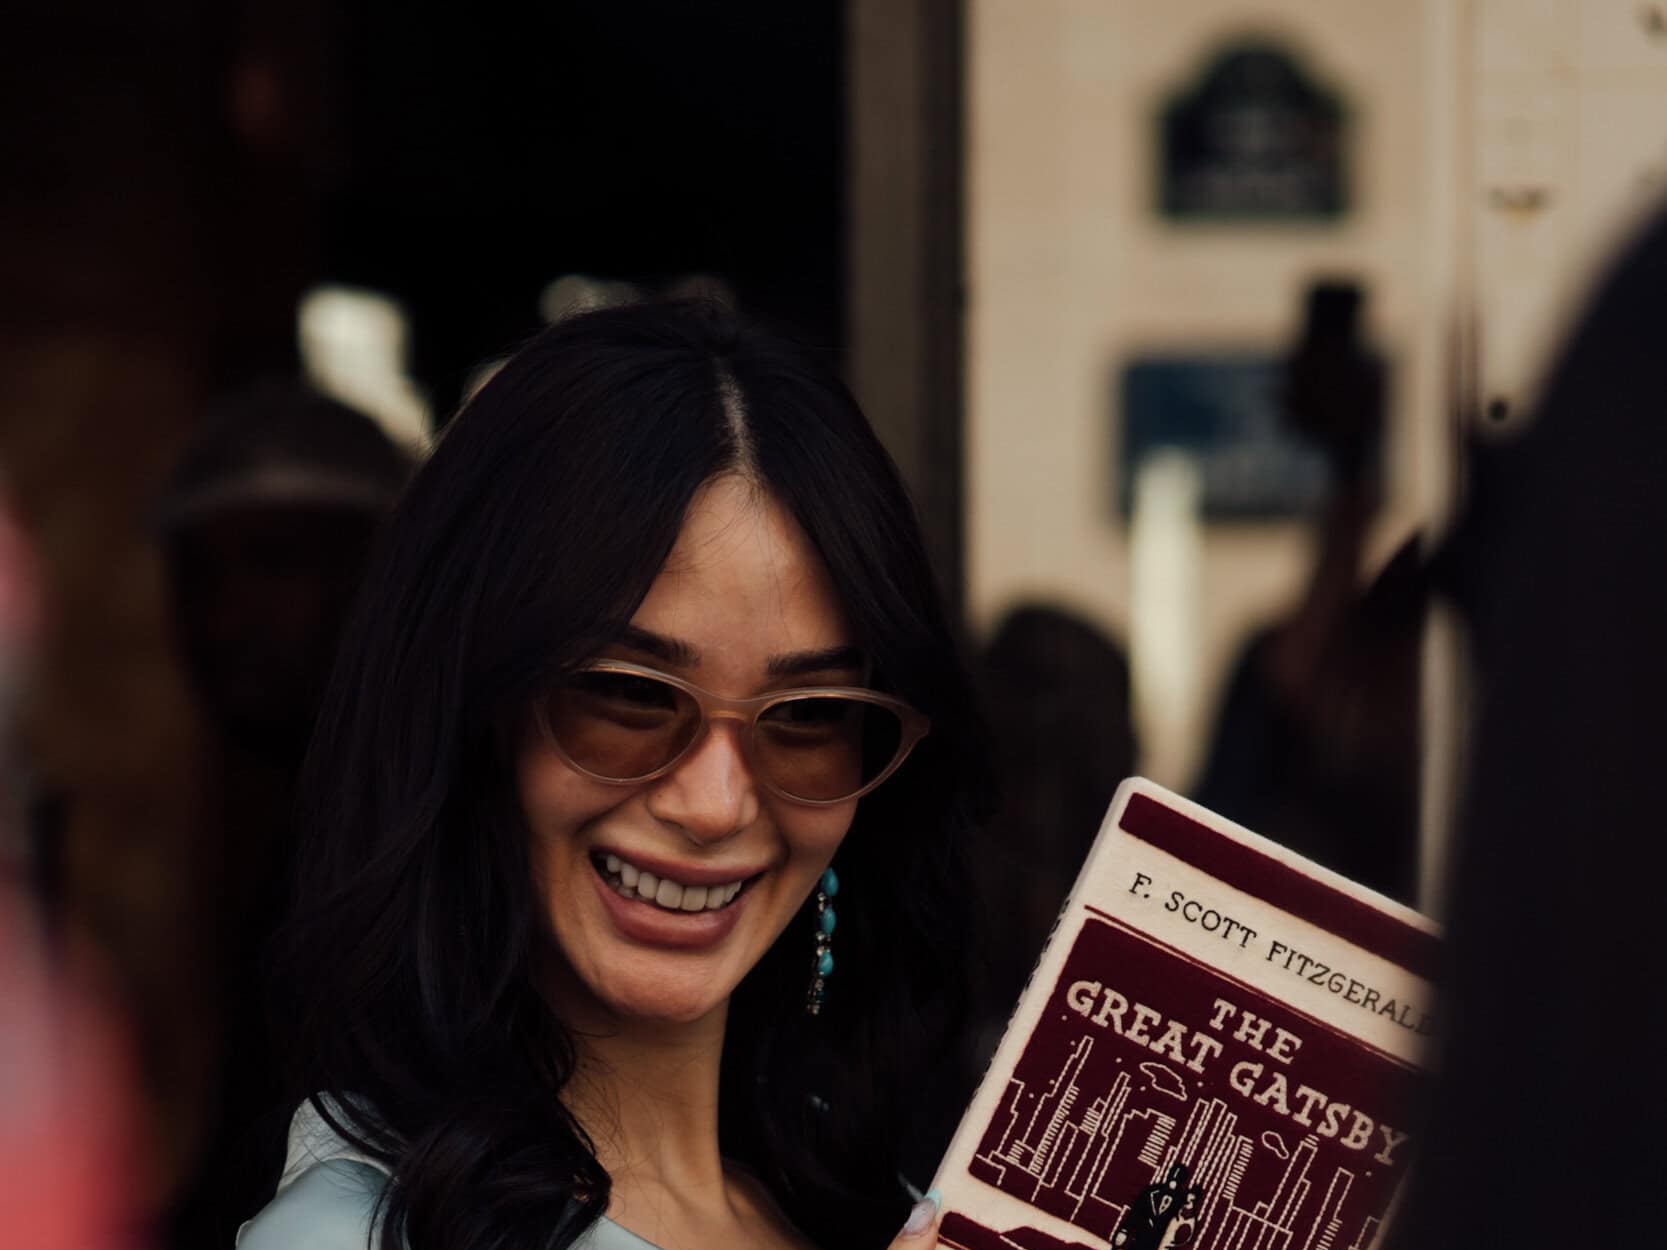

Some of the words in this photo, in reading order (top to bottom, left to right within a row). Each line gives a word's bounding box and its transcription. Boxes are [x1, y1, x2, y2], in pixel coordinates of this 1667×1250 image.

[1129, 872, 1153, 899] F.
[1164, 890, 1257, 949] SCOTT
[1209, 998, 1303, 1065] THE
[1066, 980, 1223, 1074] GREAT
[1230, 1060, 1410, 1166] GATSBY
